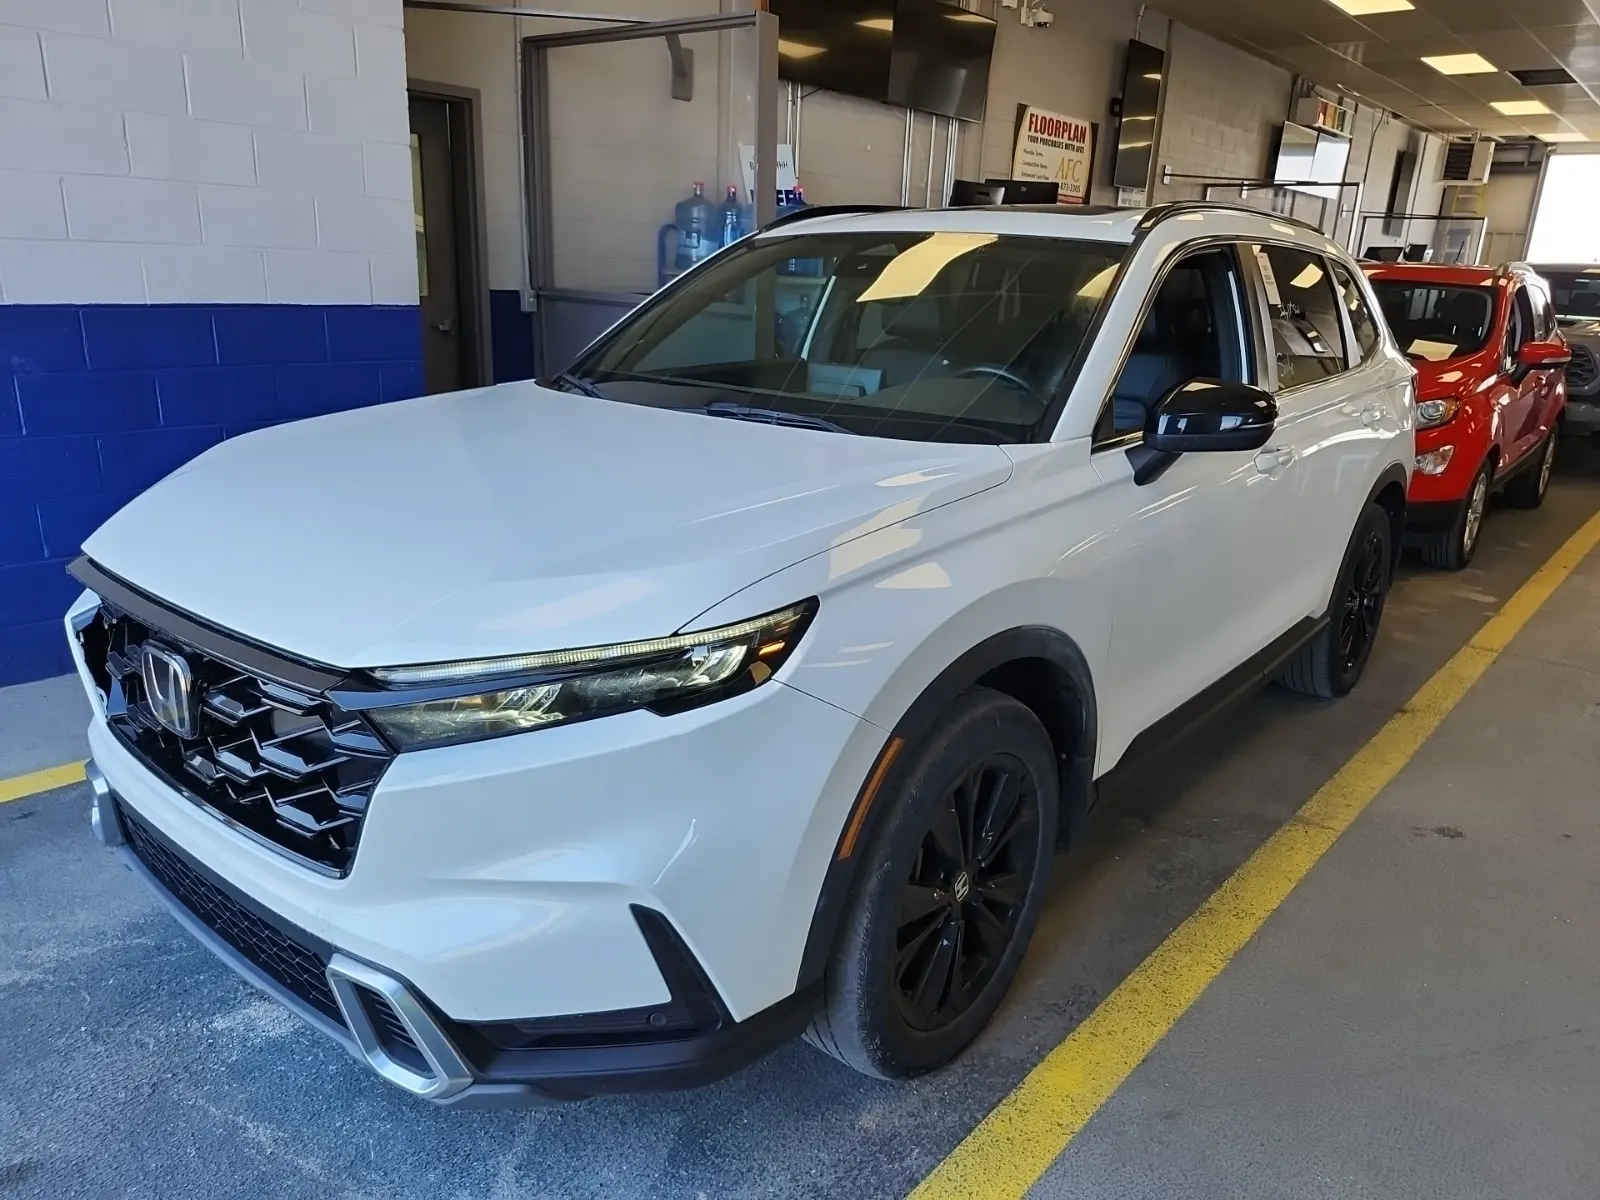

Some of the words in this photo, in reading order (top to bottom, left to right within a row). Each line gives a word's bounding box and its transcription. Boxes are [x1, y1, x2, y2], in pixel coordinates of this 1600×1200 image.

[1028, 113, 1087, 144] FLOORPLAN
[1027, 134, 1039, 144] YOUR
[1039, 136, 1064, 150] PURCHASES
[1064, 142, 1076, 152] WITH
[1055, 157, 1083, 182] AFC
